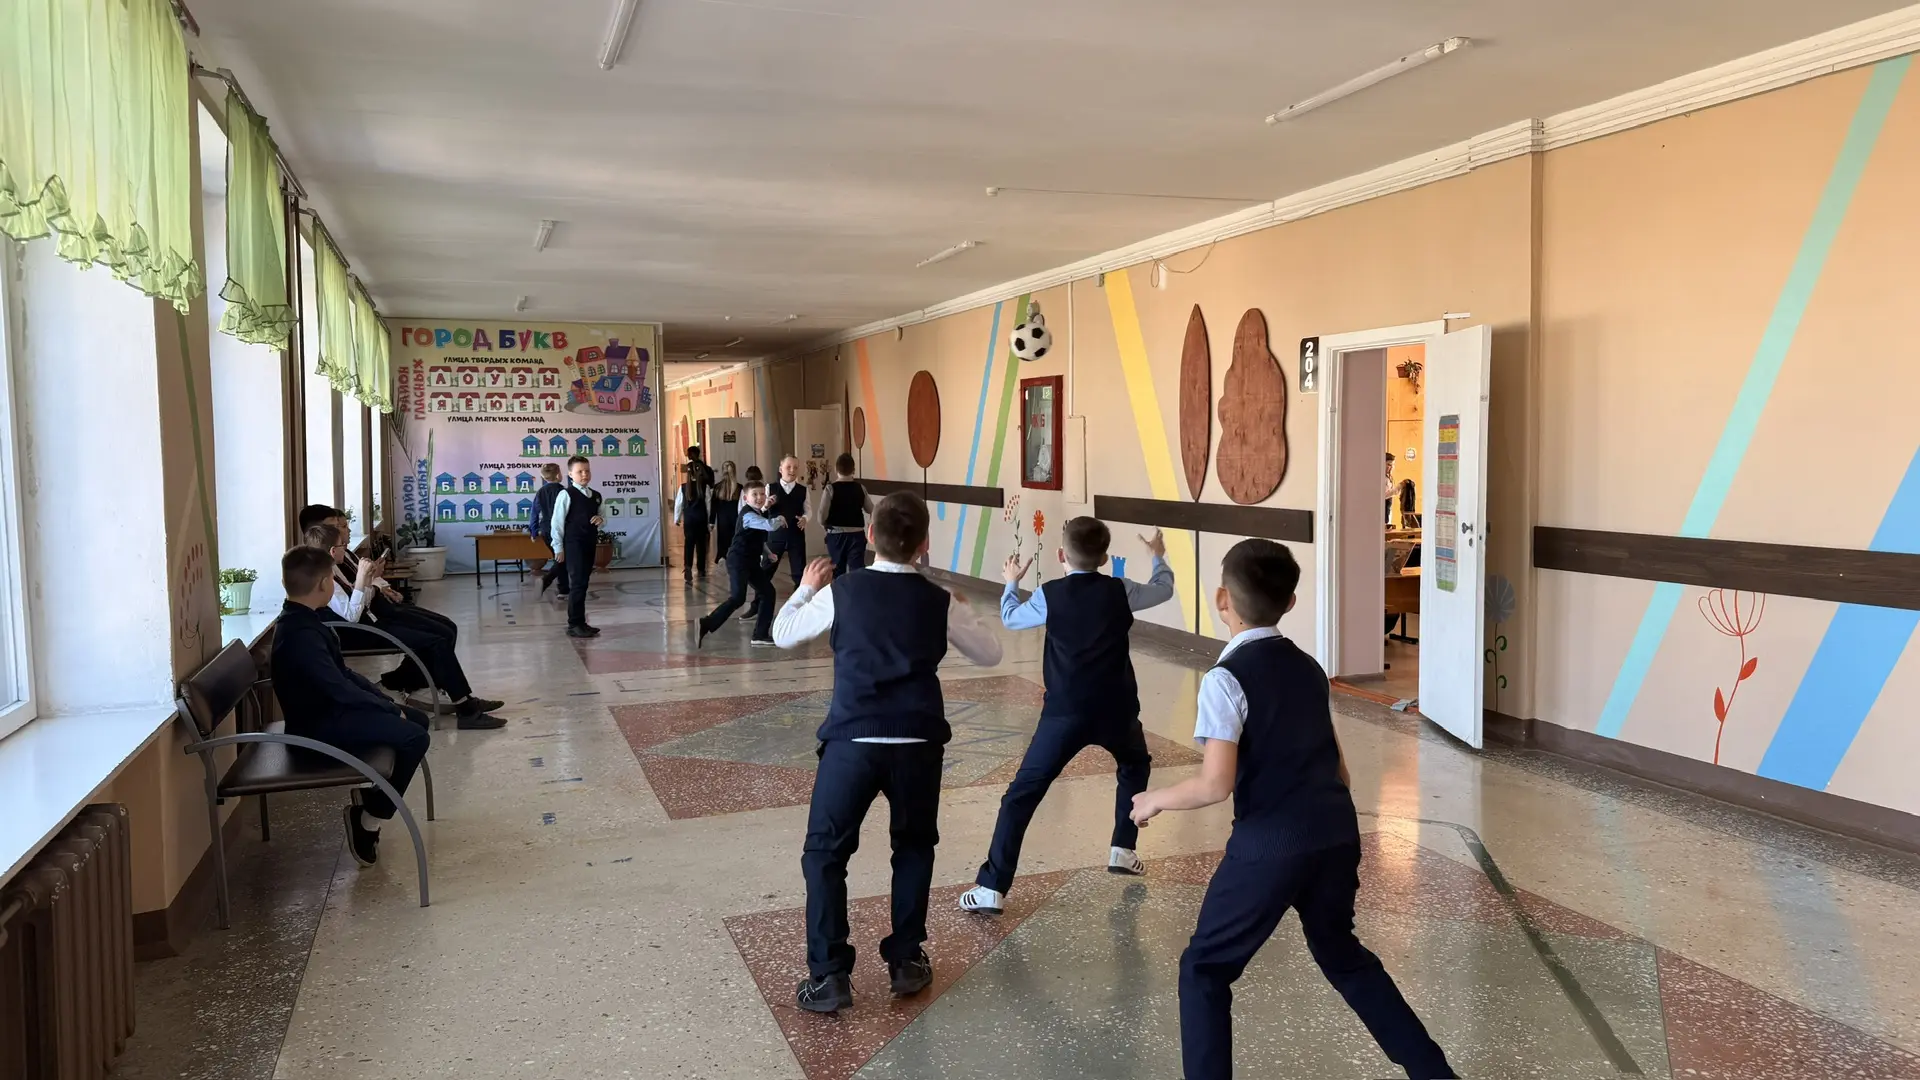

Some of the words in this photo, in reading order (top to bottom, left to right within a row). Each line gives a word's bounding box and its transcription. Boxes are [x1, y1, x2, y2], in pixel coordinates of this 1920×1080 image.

[402, 327, 493, 351] ГОРОД
[499, 329, 568, 351] БУКВ
[510, 357, 544, 365] КОМАНД
[1305, 341, 1313, 390] 204
[436, 373, 446, 384] А
[463, 373, 473, 384] О
[490, 374, 500, 385] У
[518, 374, 527, 385] Э
[543, 375, 555, 385] Ы
[398, 366, 410, 413] РАЙОН
[413, 359, 425, 420] ГЛАСНЫХ
[437, 400, 447, 410] Я
[465, 398, 473, 410] Ё
[490, 400, 502, 410] Ю
[519, 400, 527, 410] Е
[545, 401, 555, 411] И
[527, 445, 536, 454] Н
[553, 445, 563, 454] М
[580, 445, 589, 454] Л
[607, 445, 615, 453] Р
[632, 442, 640, 453] Й
[441, 481, 450, 491] Б
[469, 481, 477, 491] В
[495, 481, 502, 491] Г
[520, 481, 529, 492] Д
[403, 476, 414, 521] РАЙОН
[442, 509, 451, 519] П
[468, 507, 479, 518] Ф
[496, 508, 504, 518] К
[521, 507, 529, 517] Т
[610, 506, 619, 516] Ъ
[635, 505, 643, 515] Ь
